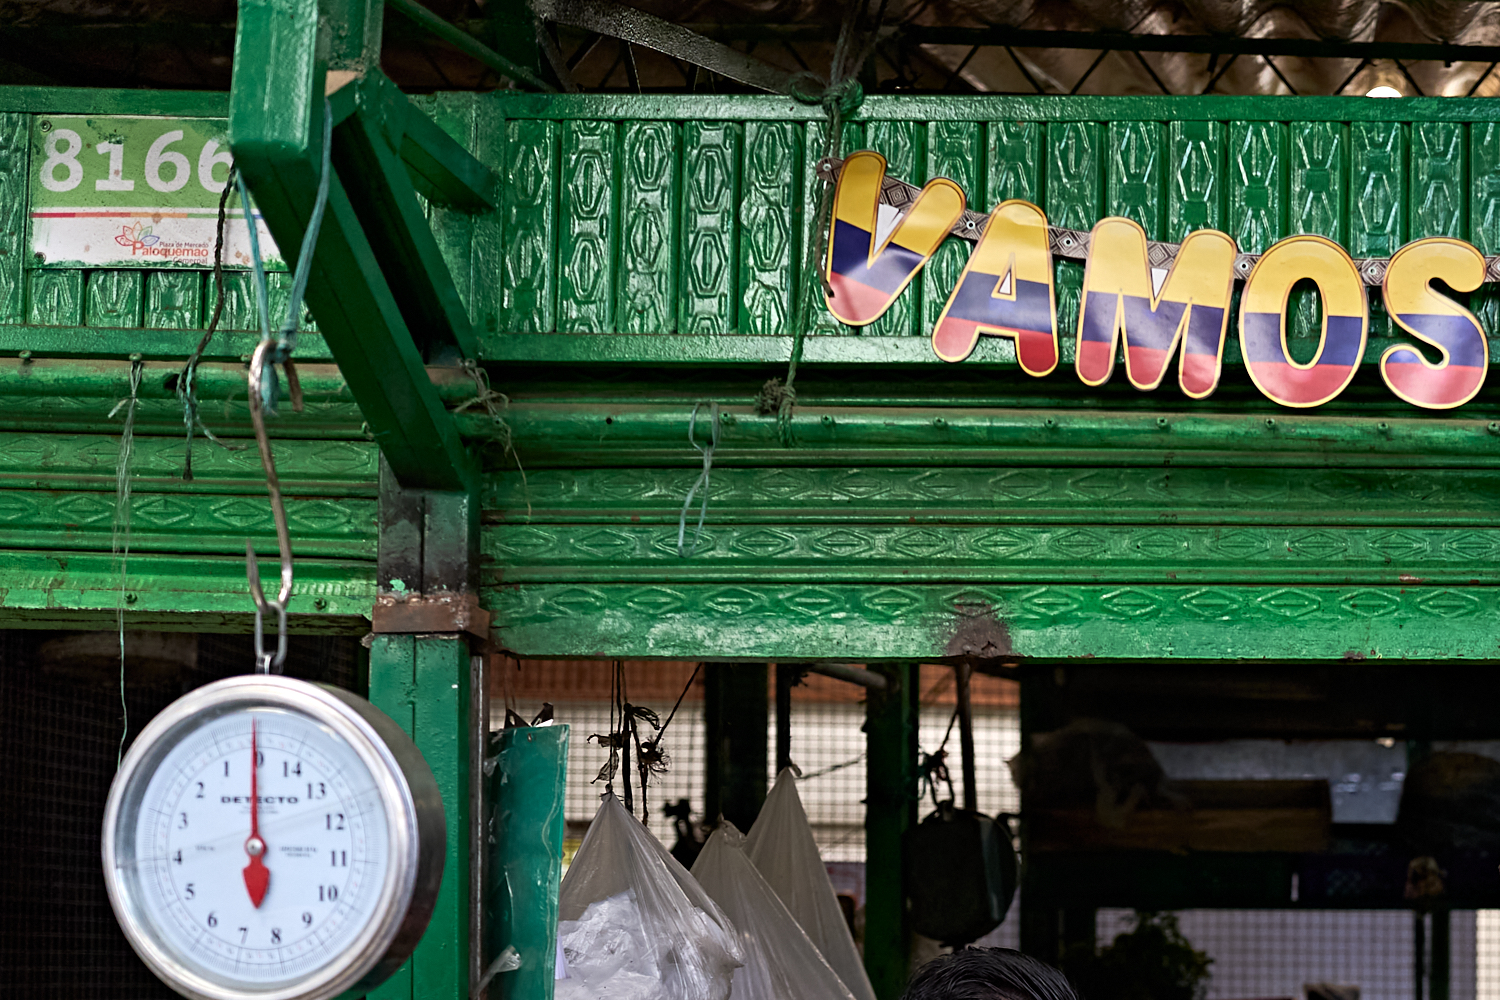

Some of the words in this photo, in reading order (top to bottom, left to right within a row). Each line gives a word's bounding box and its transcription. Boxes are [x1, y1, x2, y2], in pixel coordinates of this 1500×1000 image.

[39, 129, 234, 194] 8166
[132, 240, 209, 258] Paloquemao
[825, 149, 1490, 410] VAMOS
[224, 761, 229, 777] 1
[282, 761, 302, 777] 14
[196, 782, 204, 799] 2
[306, 782, 326, 800] 13
[178, 812, 188, 829] 3
[325, 813, 345, 831] 12
[172, 849, 183, 865] 4
[330, 850, 347, 867] 11
[185, 883, 195, 900] 5
[318, 885, 338, 902] 10
[208, 911, 218, 928] 6
[302, 911, 312, 928] 9
[238, 927, 248, 944] 7
[271, 928, 281, 944] 8
